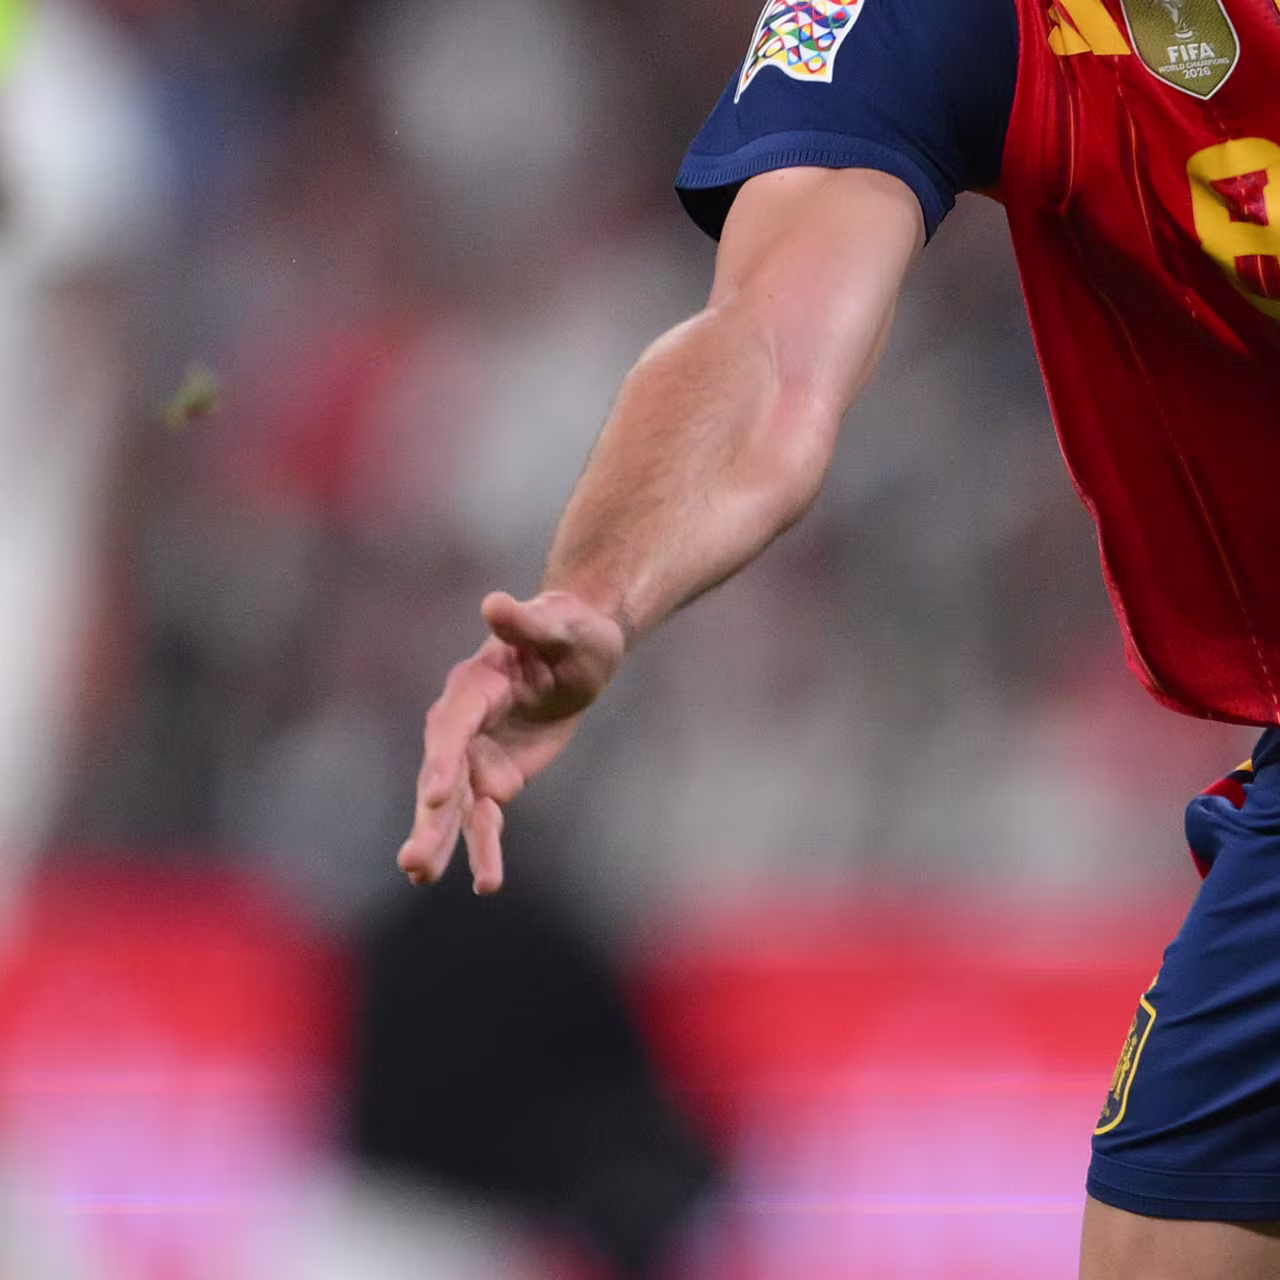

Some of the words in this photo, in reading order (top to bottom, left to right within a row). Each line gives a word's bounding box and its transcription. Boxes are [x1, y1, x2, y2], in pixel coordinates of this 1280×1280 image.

[1167, 42, 1215, 63] FIFA
[1158, 63, 1185, 73] WORLD
[1186, 57, 1230, 68] CHAMPIONS
[1183, 66, 1211, 79] 2026
